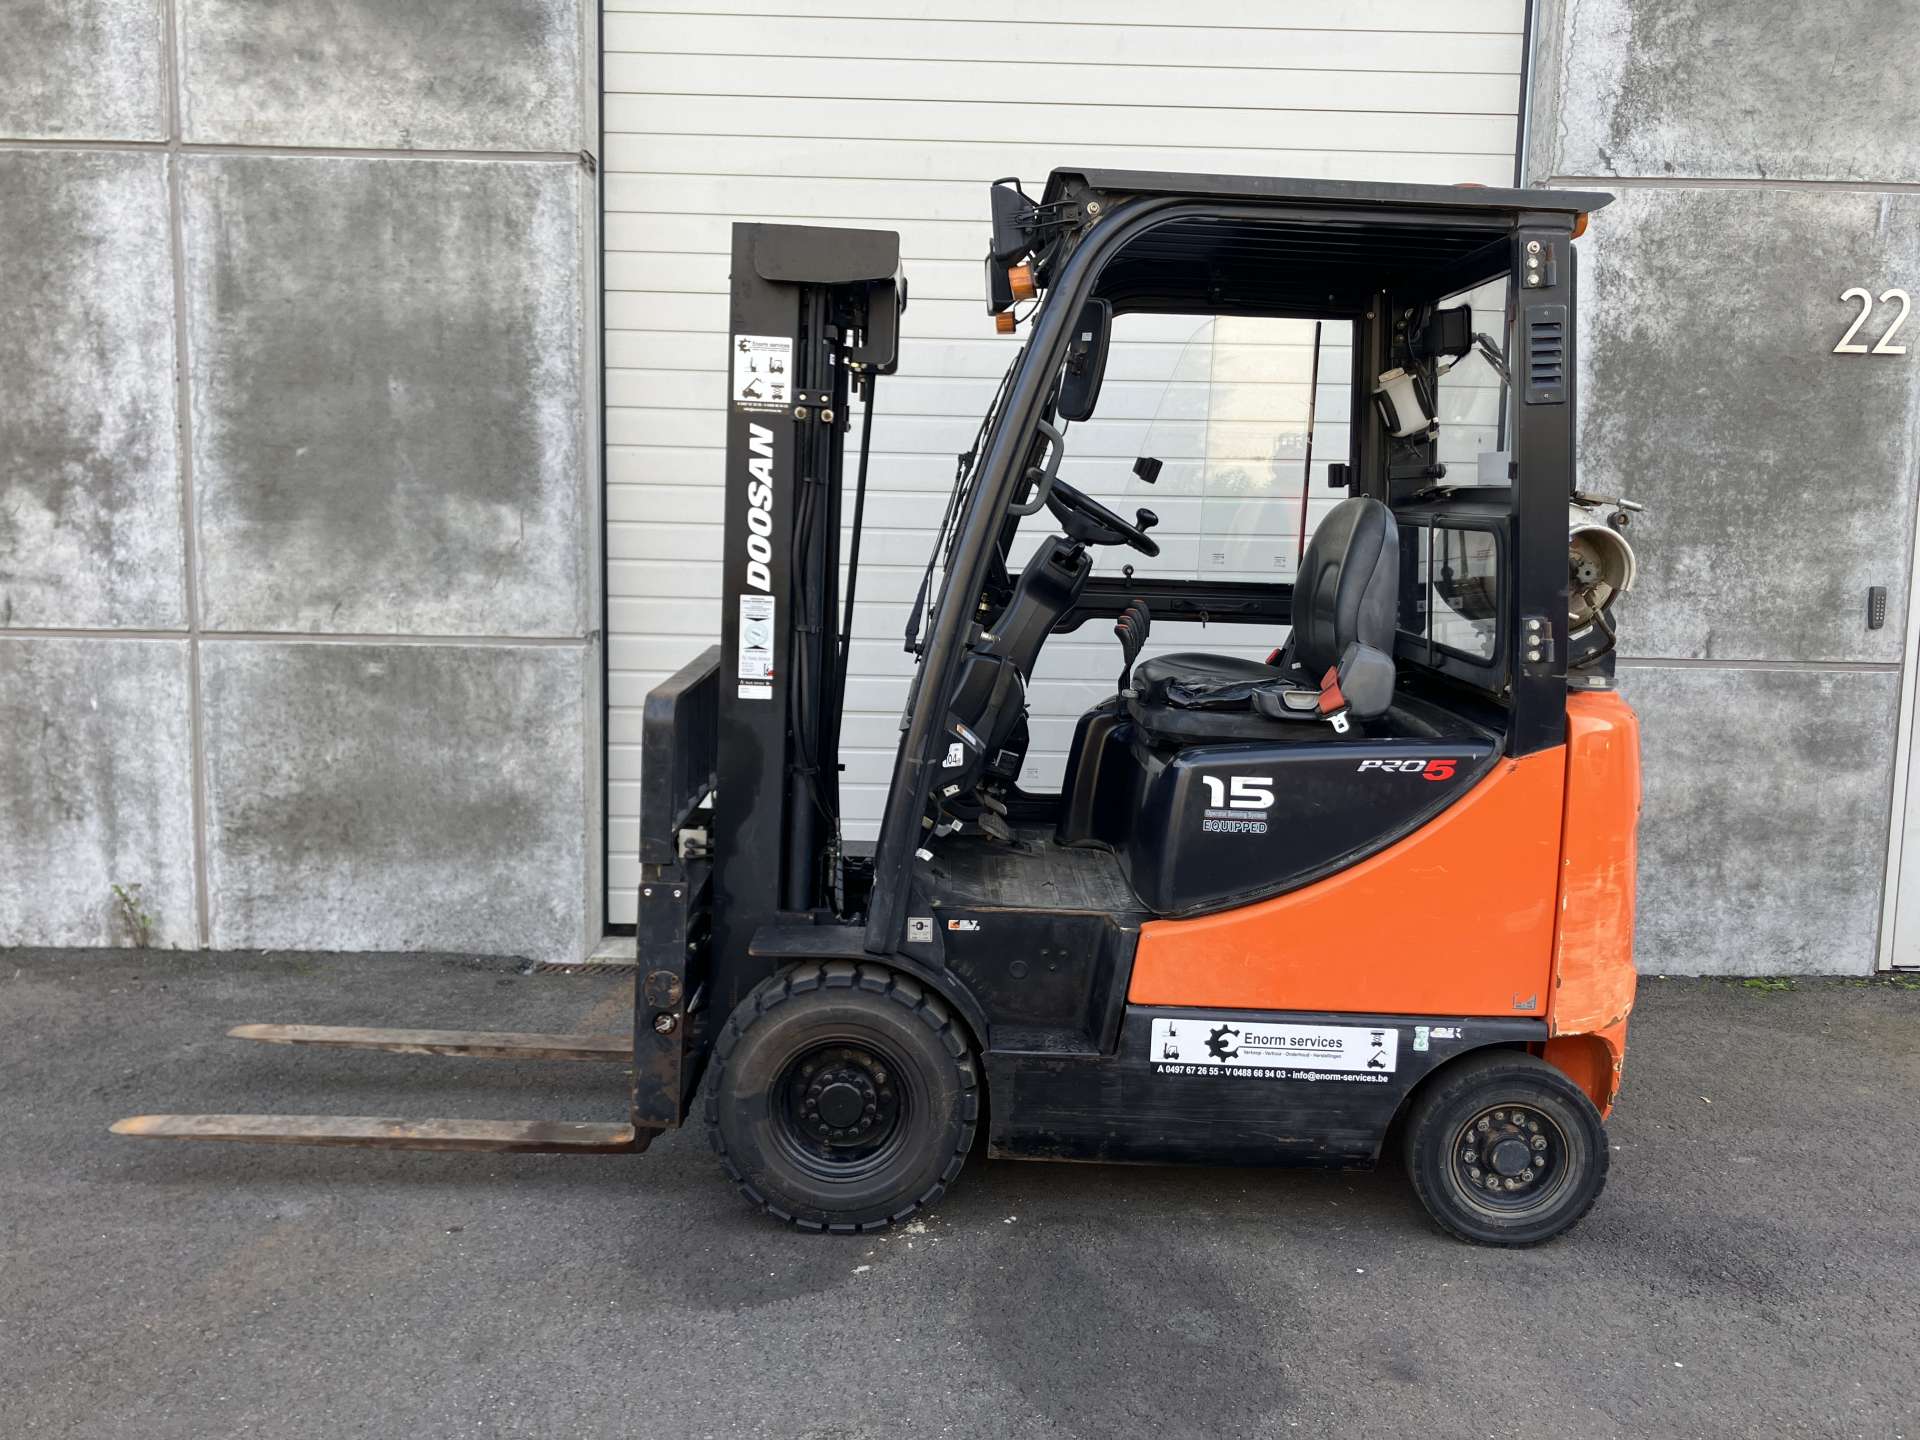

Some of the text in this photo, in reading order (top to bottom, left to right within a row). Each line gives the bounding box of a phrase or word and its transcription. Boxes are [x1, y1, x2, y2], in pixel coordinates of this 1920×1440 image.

[1833, 287, 1910, 354] 22
[746, 423, 774, 592] DOOSAN
[1202, 775, 1275, 809] 15
[1202, 819, 1268, 834] EQUIPPED
[1244, 1032, 1343, 1048] Enorm services
[1157, 1064, 1164, 1073] A
[1165, 1065, 1185, 1074] 0497
[1186, 1066, 1196, 1075] 67
[1197, 1066, 1207, 1075] 26
[1208, 1067, 1219, 1076] 55
[1225, 1067, 1232, 1076] V
[1276, 1070, 1286, 1078] 03
[1292, 1071, 1388, 1082] info@enorm-services.be
